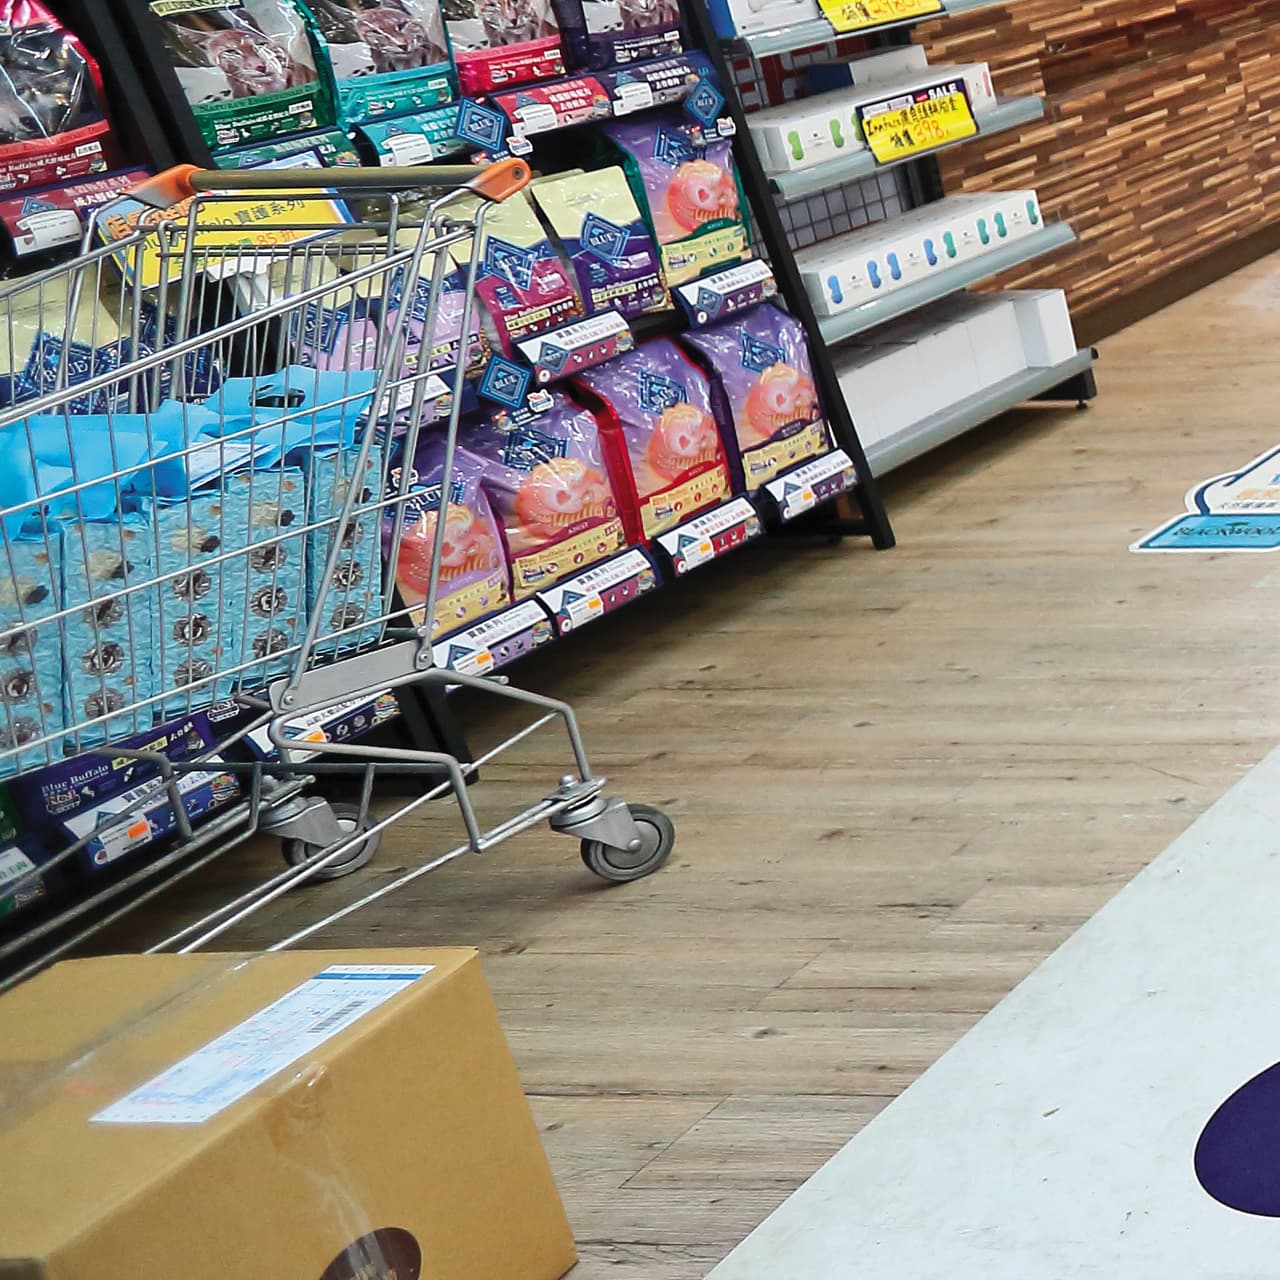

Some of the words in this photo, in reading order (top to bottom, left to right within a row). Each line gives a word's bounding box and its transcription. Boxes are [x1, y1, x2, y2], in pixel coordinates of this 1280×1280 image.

[927, 83, 958, 100] SALE
[590, 231, 615, 246] BLUE
[495, 374, 517, 389] BLUE
[41, 781, 67, 797] Blue
[70, 764, 109, 785] Buffalo
